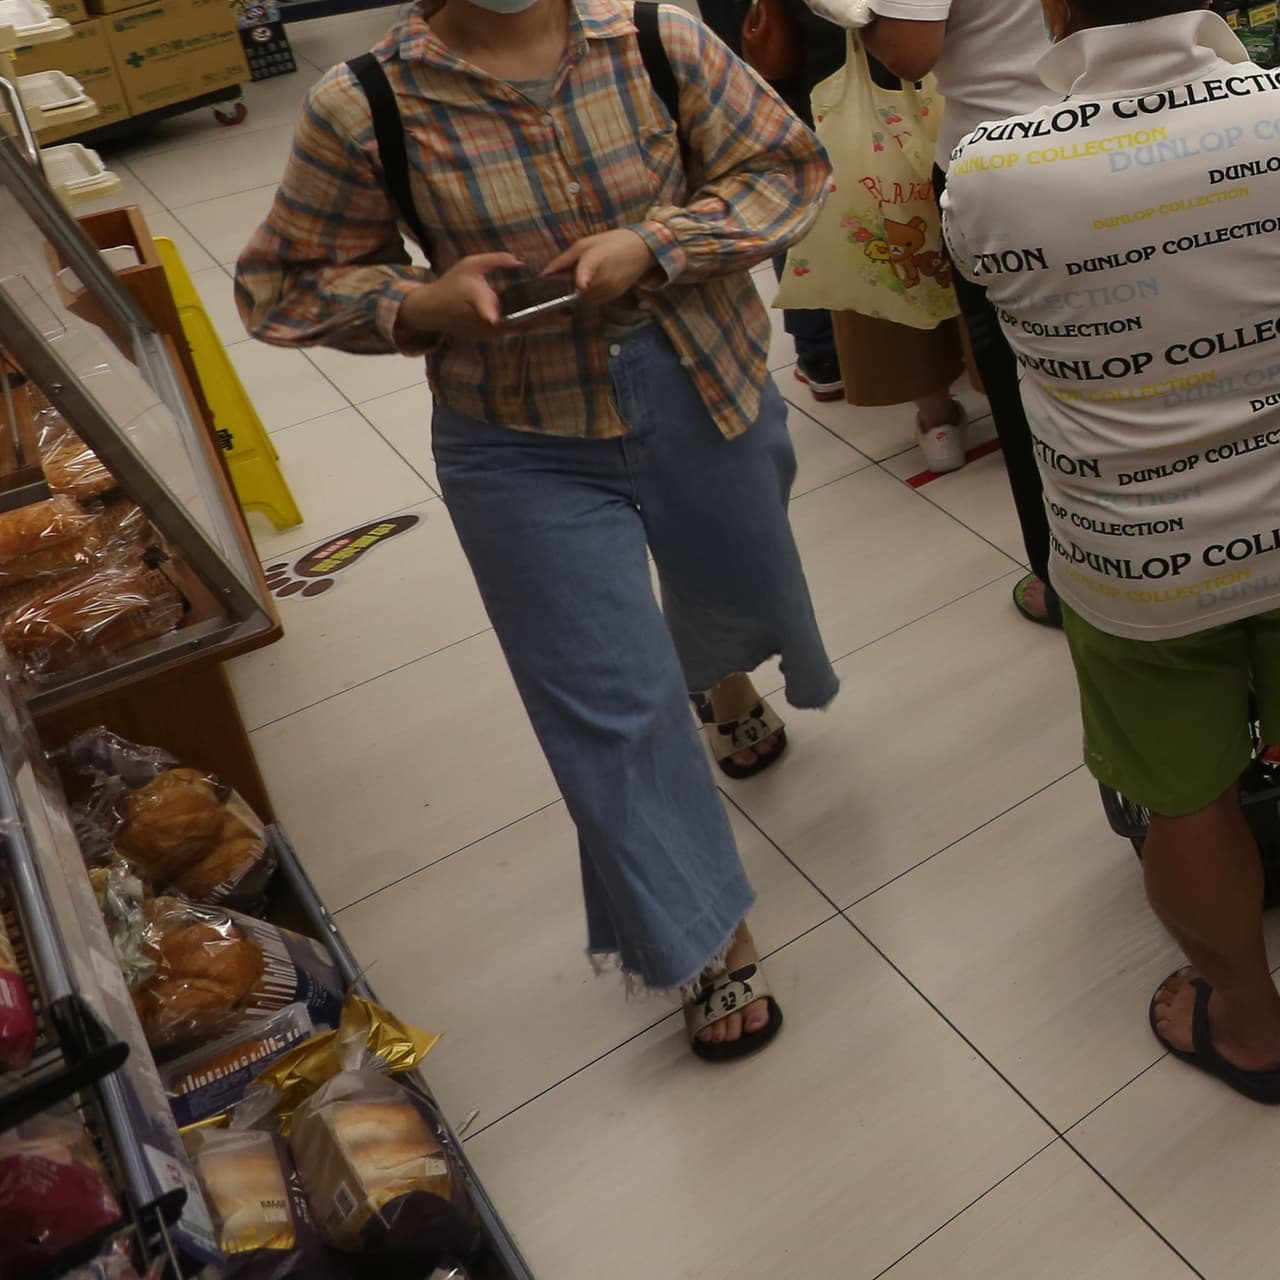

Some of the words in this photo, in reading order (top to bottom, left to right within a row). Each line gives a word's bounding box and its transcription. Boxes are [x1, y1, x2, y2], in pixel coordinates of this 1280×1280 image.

[968, 102, 1101, 146] DUNLOP
[953, 153, 1019, 177] DUNLOP
[1026, 127, 1168, 166] COLLECTION
[1108, 126, 1243, 174] DUNLOP
[1091, 205, 1155, 231] DUNLOP
[1158, 185, 1250, 218] COLLECTION
[1065, 244, 1157, 276] DUNLOP
[1021, 315, 1143, 338] COLLECTION
[1022, 351, 1153, 381] DUNLOP
[1118, 455, 1201, 487] DUNLOP
[1071, 513, 1184, 538] COLLECTION
[1070, 541, 1193, 581] DUNLOP
